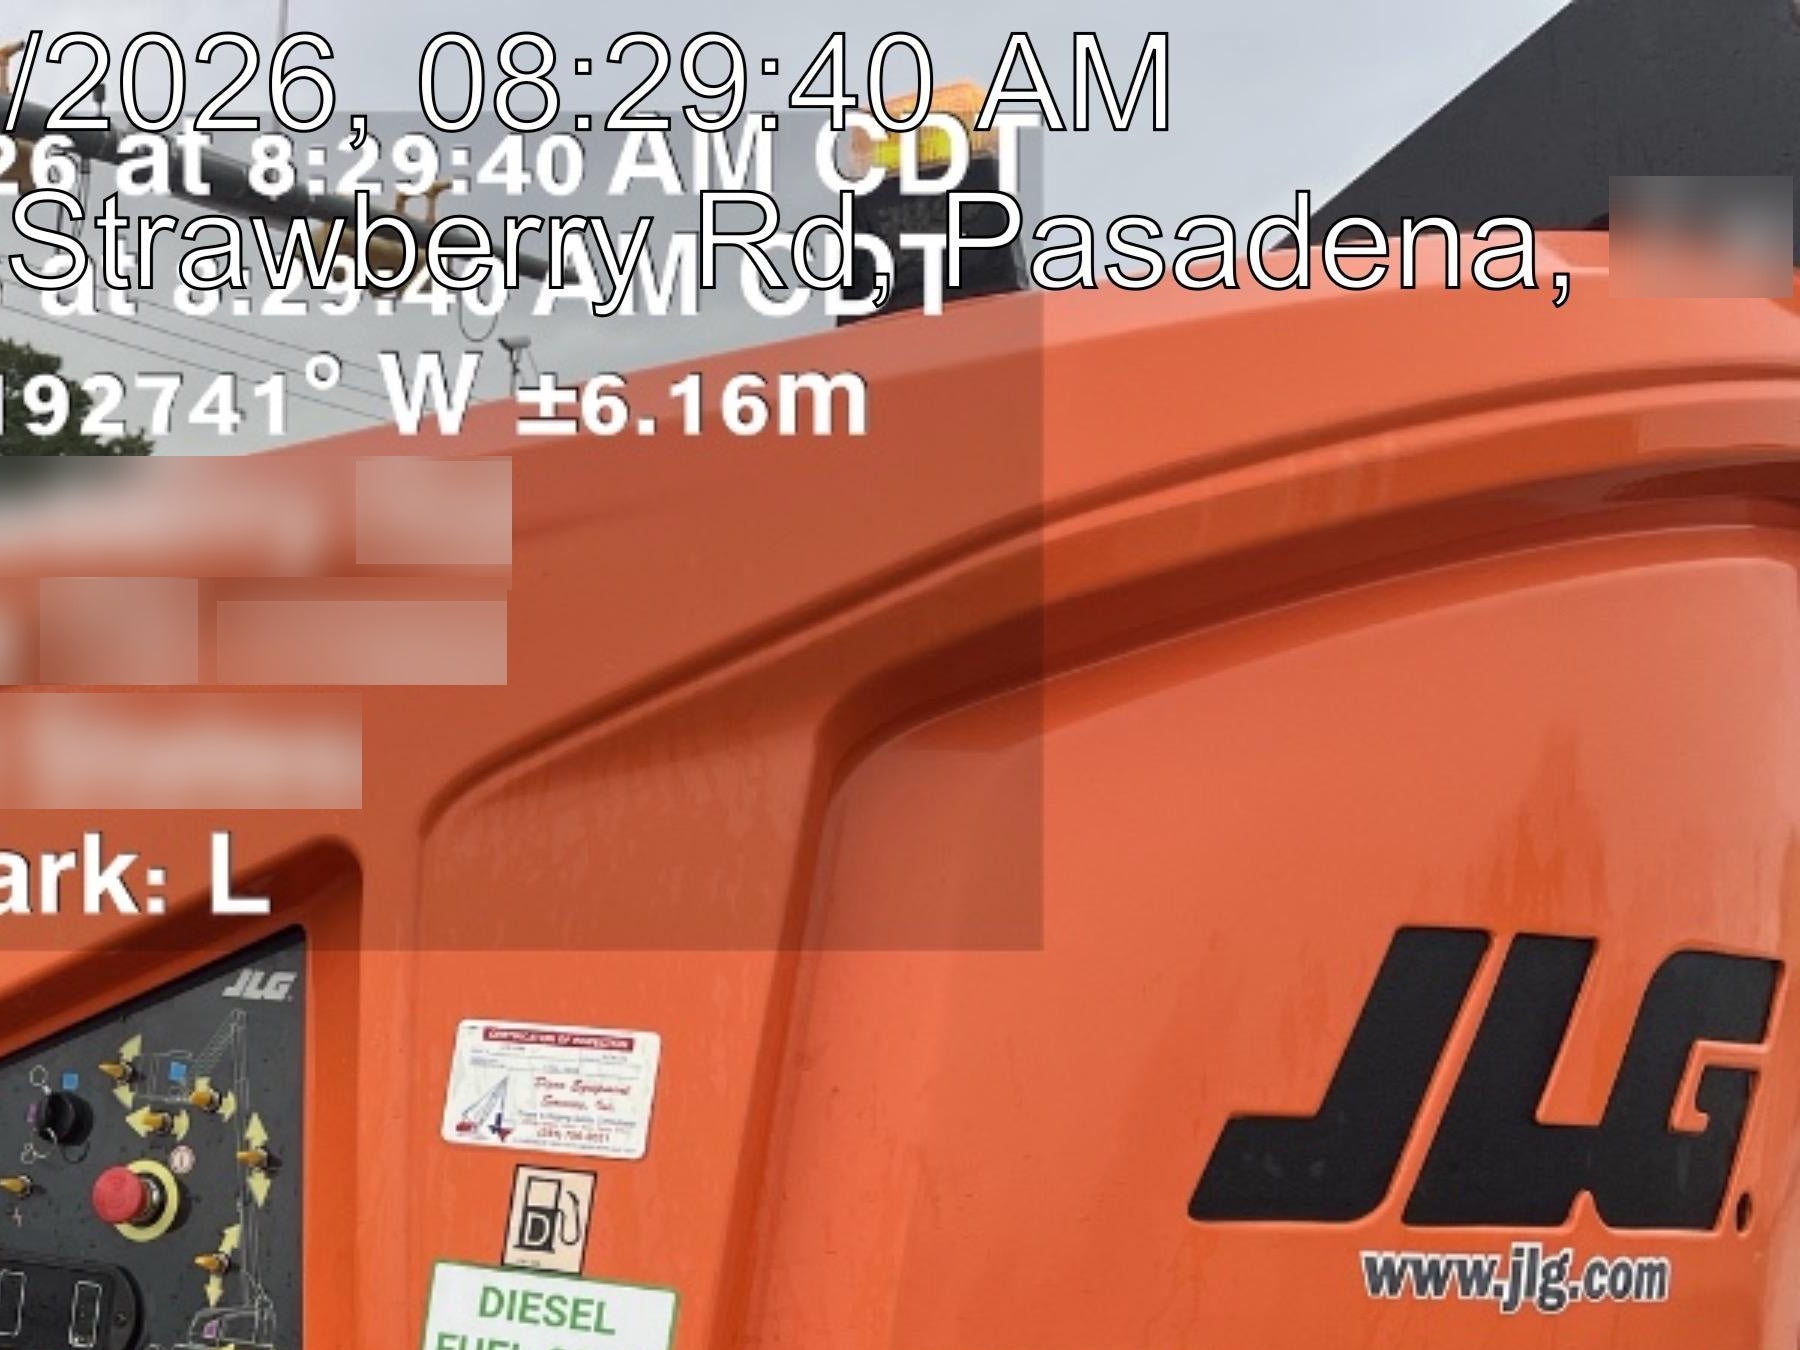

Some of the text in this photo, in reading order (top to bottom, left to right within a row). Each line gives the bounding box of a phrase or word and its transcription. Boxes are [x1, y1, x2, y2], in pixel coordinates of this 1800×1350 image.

[223, 968, 297, 1001] JLG
[1188, 925, 1784, 1232] JLG
[1360, 1241, 1670, 1314] www.jlg.com
[478, 1285, 616, 1336] DIESEL
